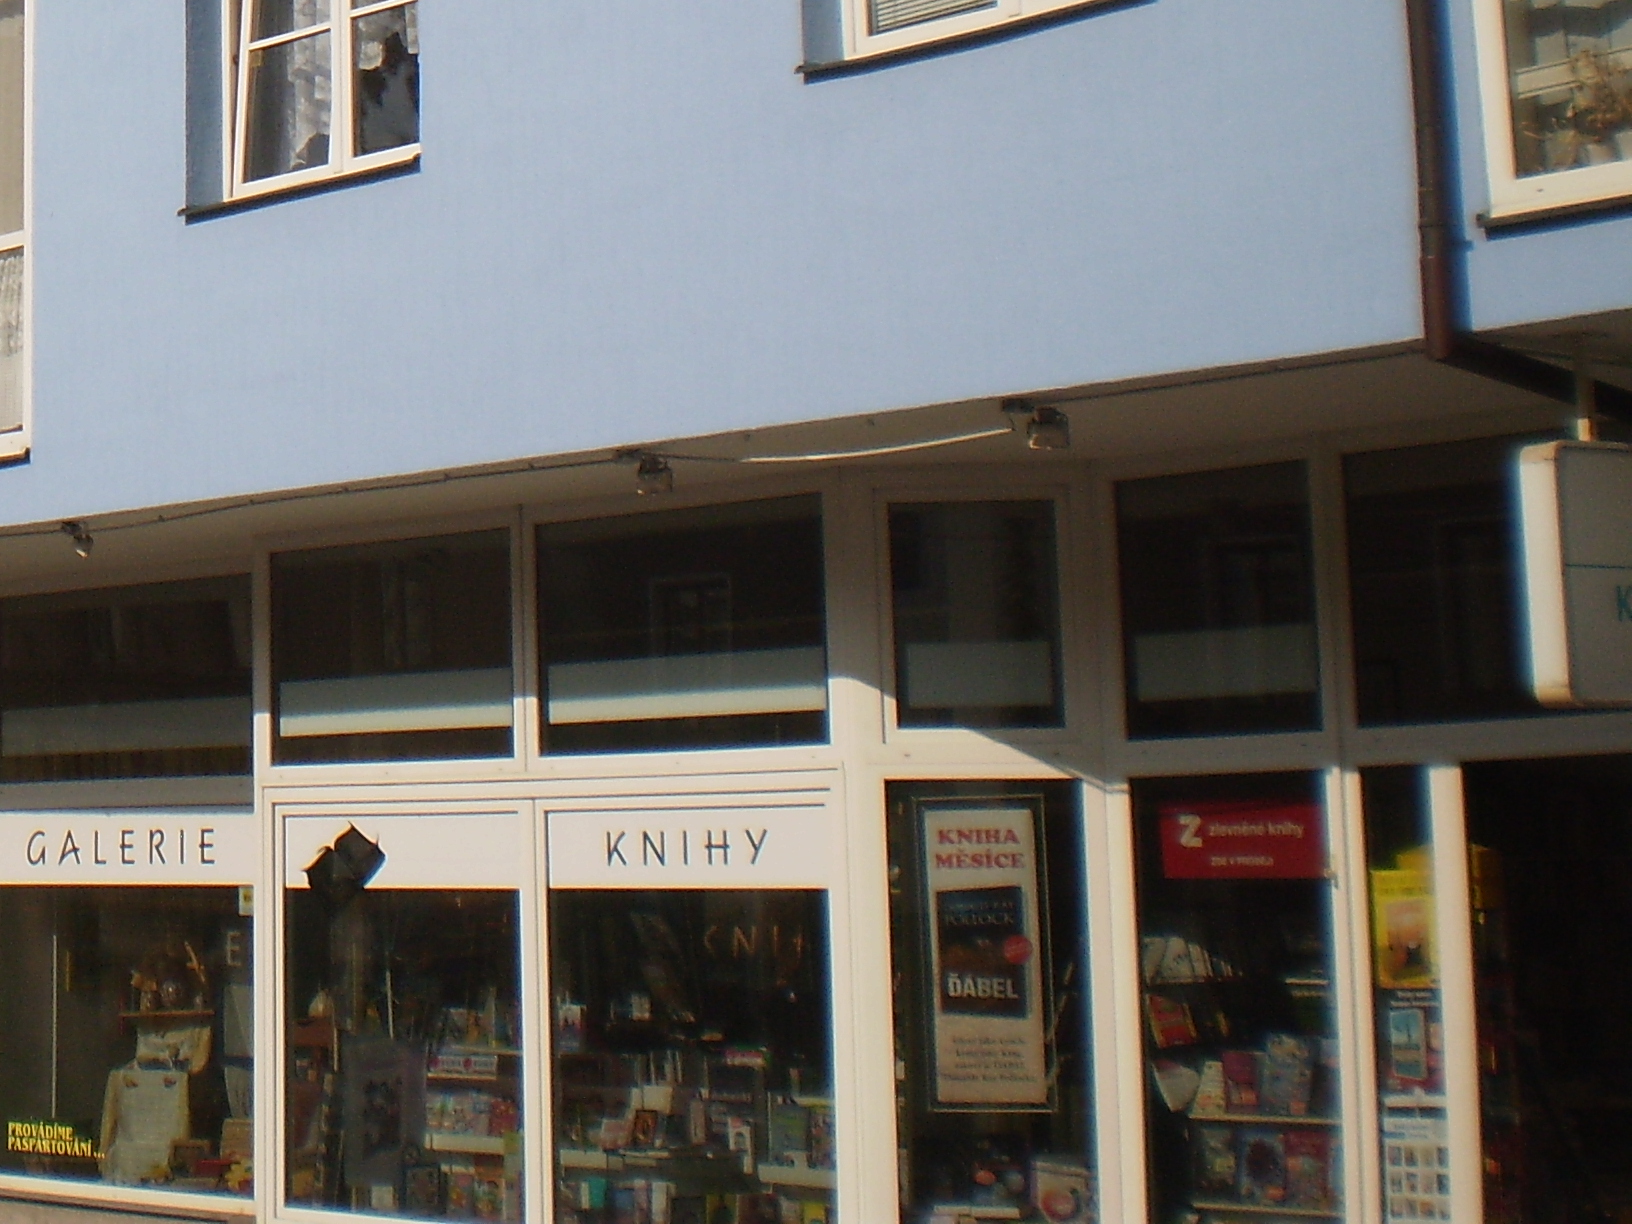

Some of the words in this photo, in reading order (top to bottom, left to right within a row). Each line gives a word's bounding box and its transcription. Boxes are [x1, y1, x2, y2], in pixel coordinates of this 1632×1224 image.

[937, 828, 1021, 845] KNIHA
[1268, 821, 1304, 839] knihy
[27, 828, 216, 866] GALERIE
[606, 828, 768, 867] KNIHY
[934, 849, 1027, 869] MĚSÍCE
[7, 1120, 74, 1141] PROVÁDÍME
